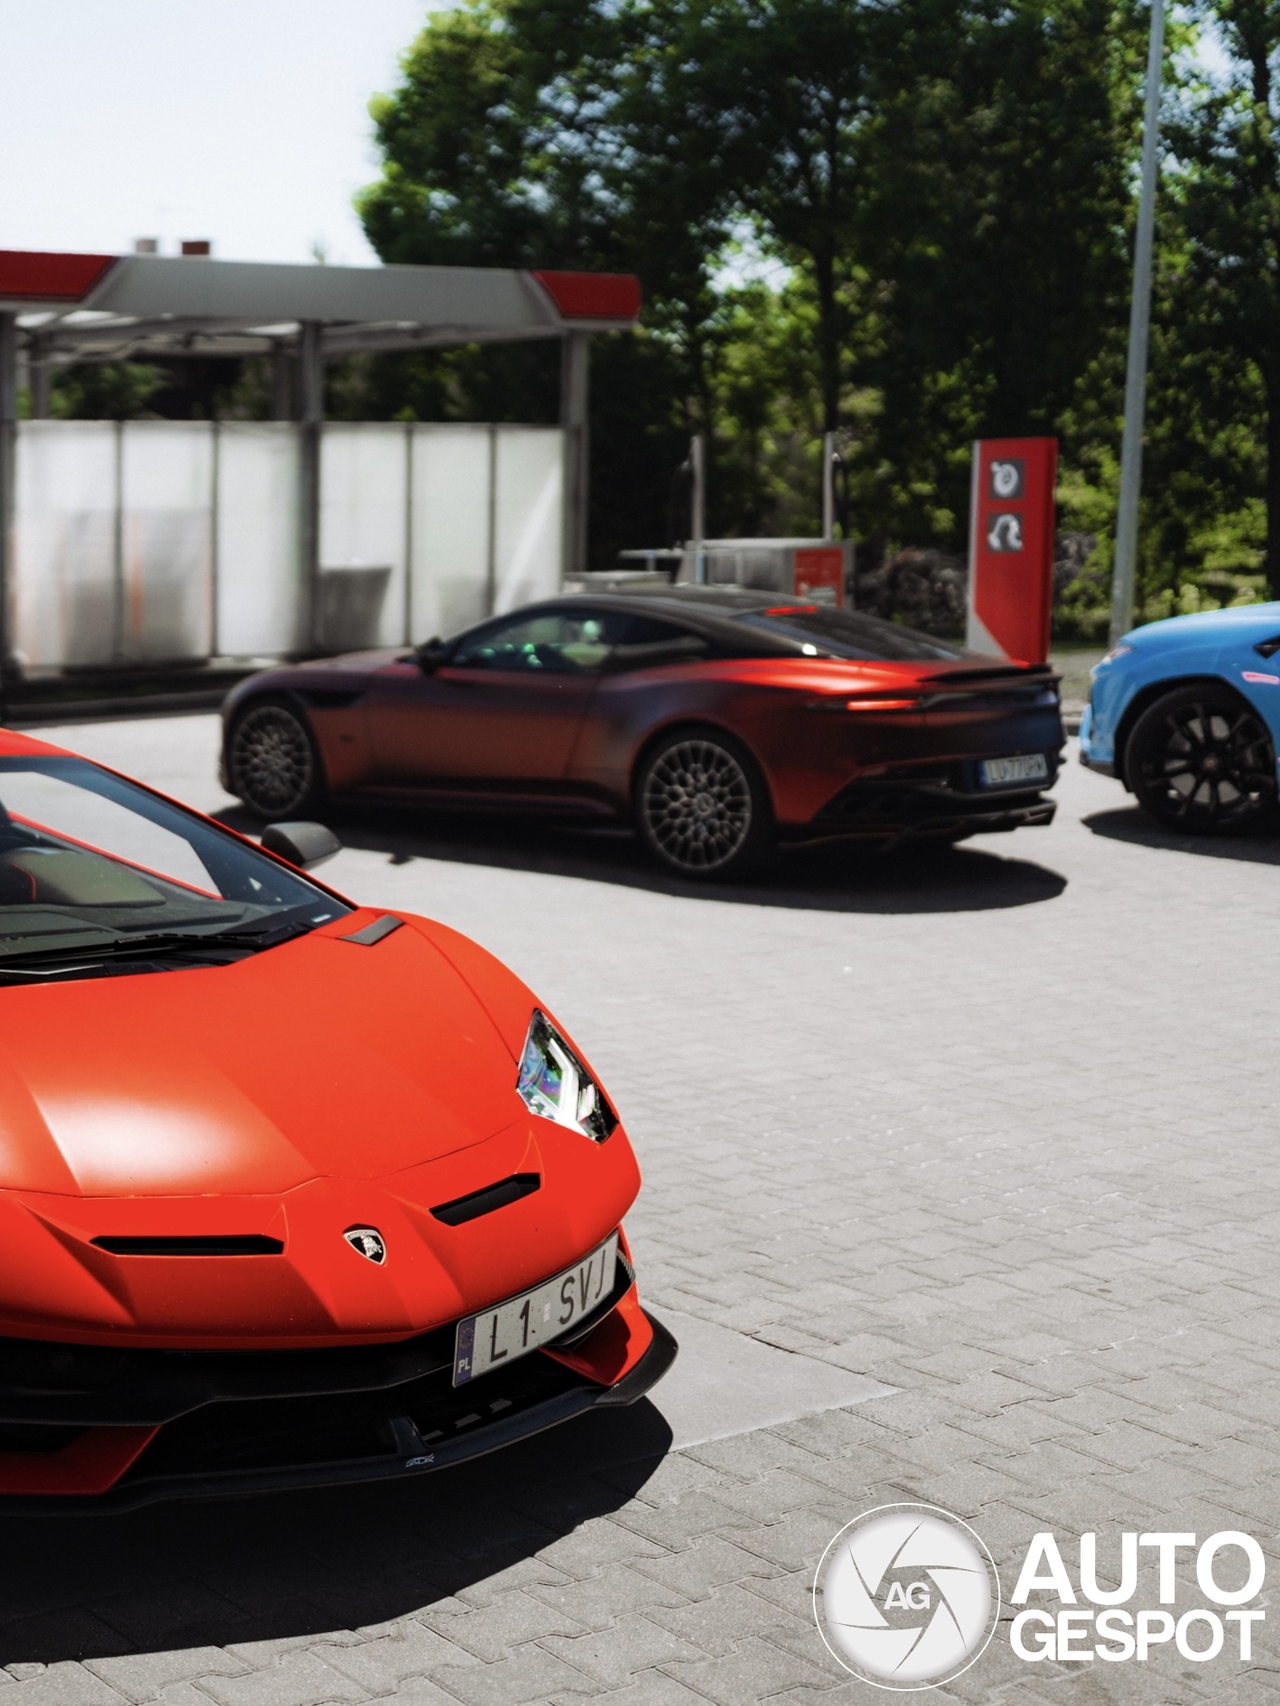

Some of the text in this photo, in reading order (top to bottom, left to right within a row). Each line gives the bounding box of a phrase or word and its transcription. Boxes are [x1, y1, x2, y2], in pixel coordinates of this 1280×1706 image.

[490, 1249, 606, 1362] L1 SVJ
[458, 1358, 470, 1374] PL
